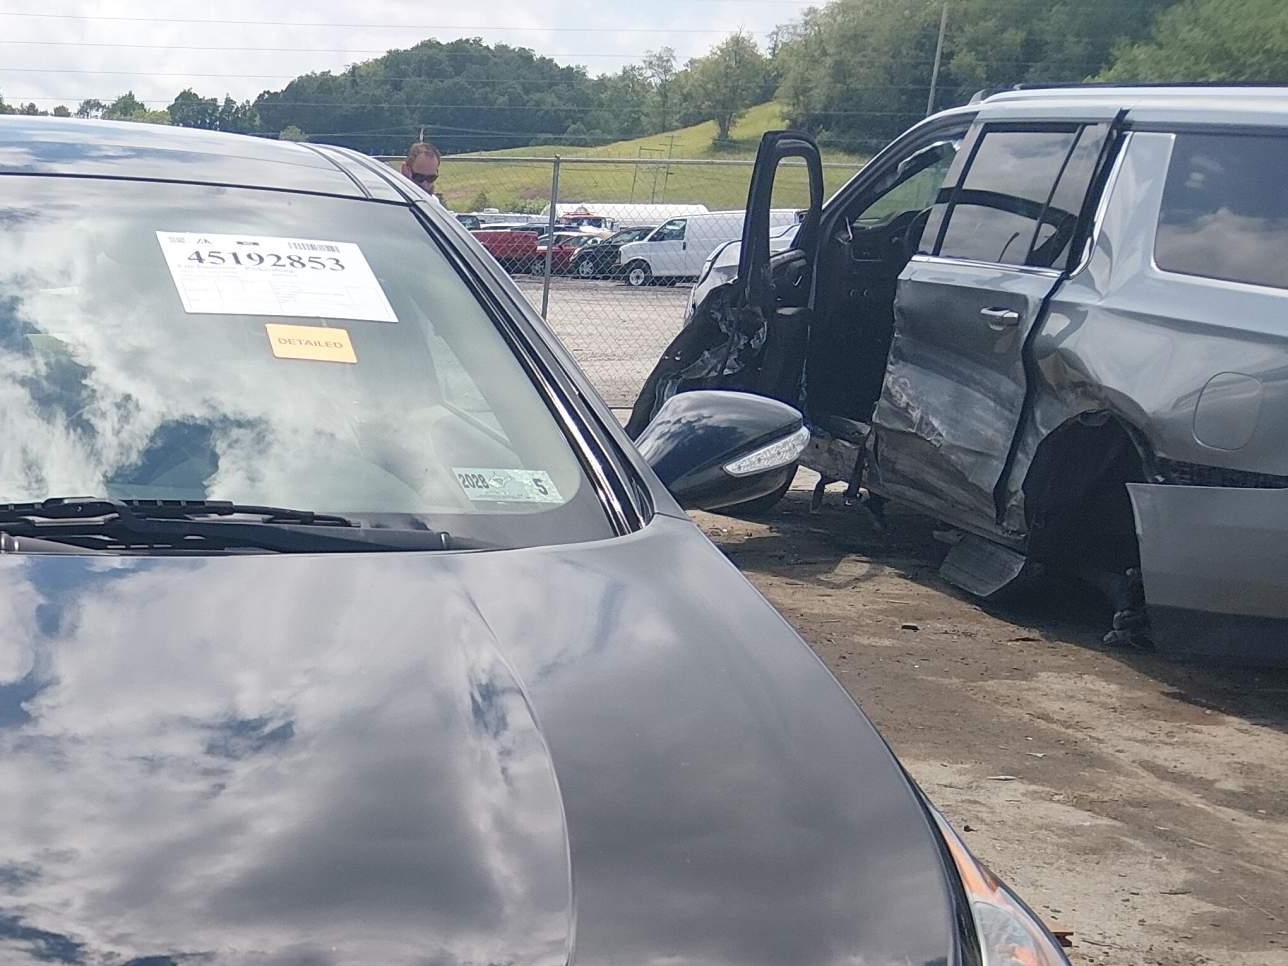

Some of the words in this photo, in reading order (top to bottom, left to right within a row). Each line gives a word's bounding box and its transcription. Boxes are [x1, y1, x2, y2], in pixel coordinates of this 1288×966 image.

[187, 250, 346, 271] 45192853
[277, 337, 343, 349] DETAILED
[532, 478, 548, 495] 5
